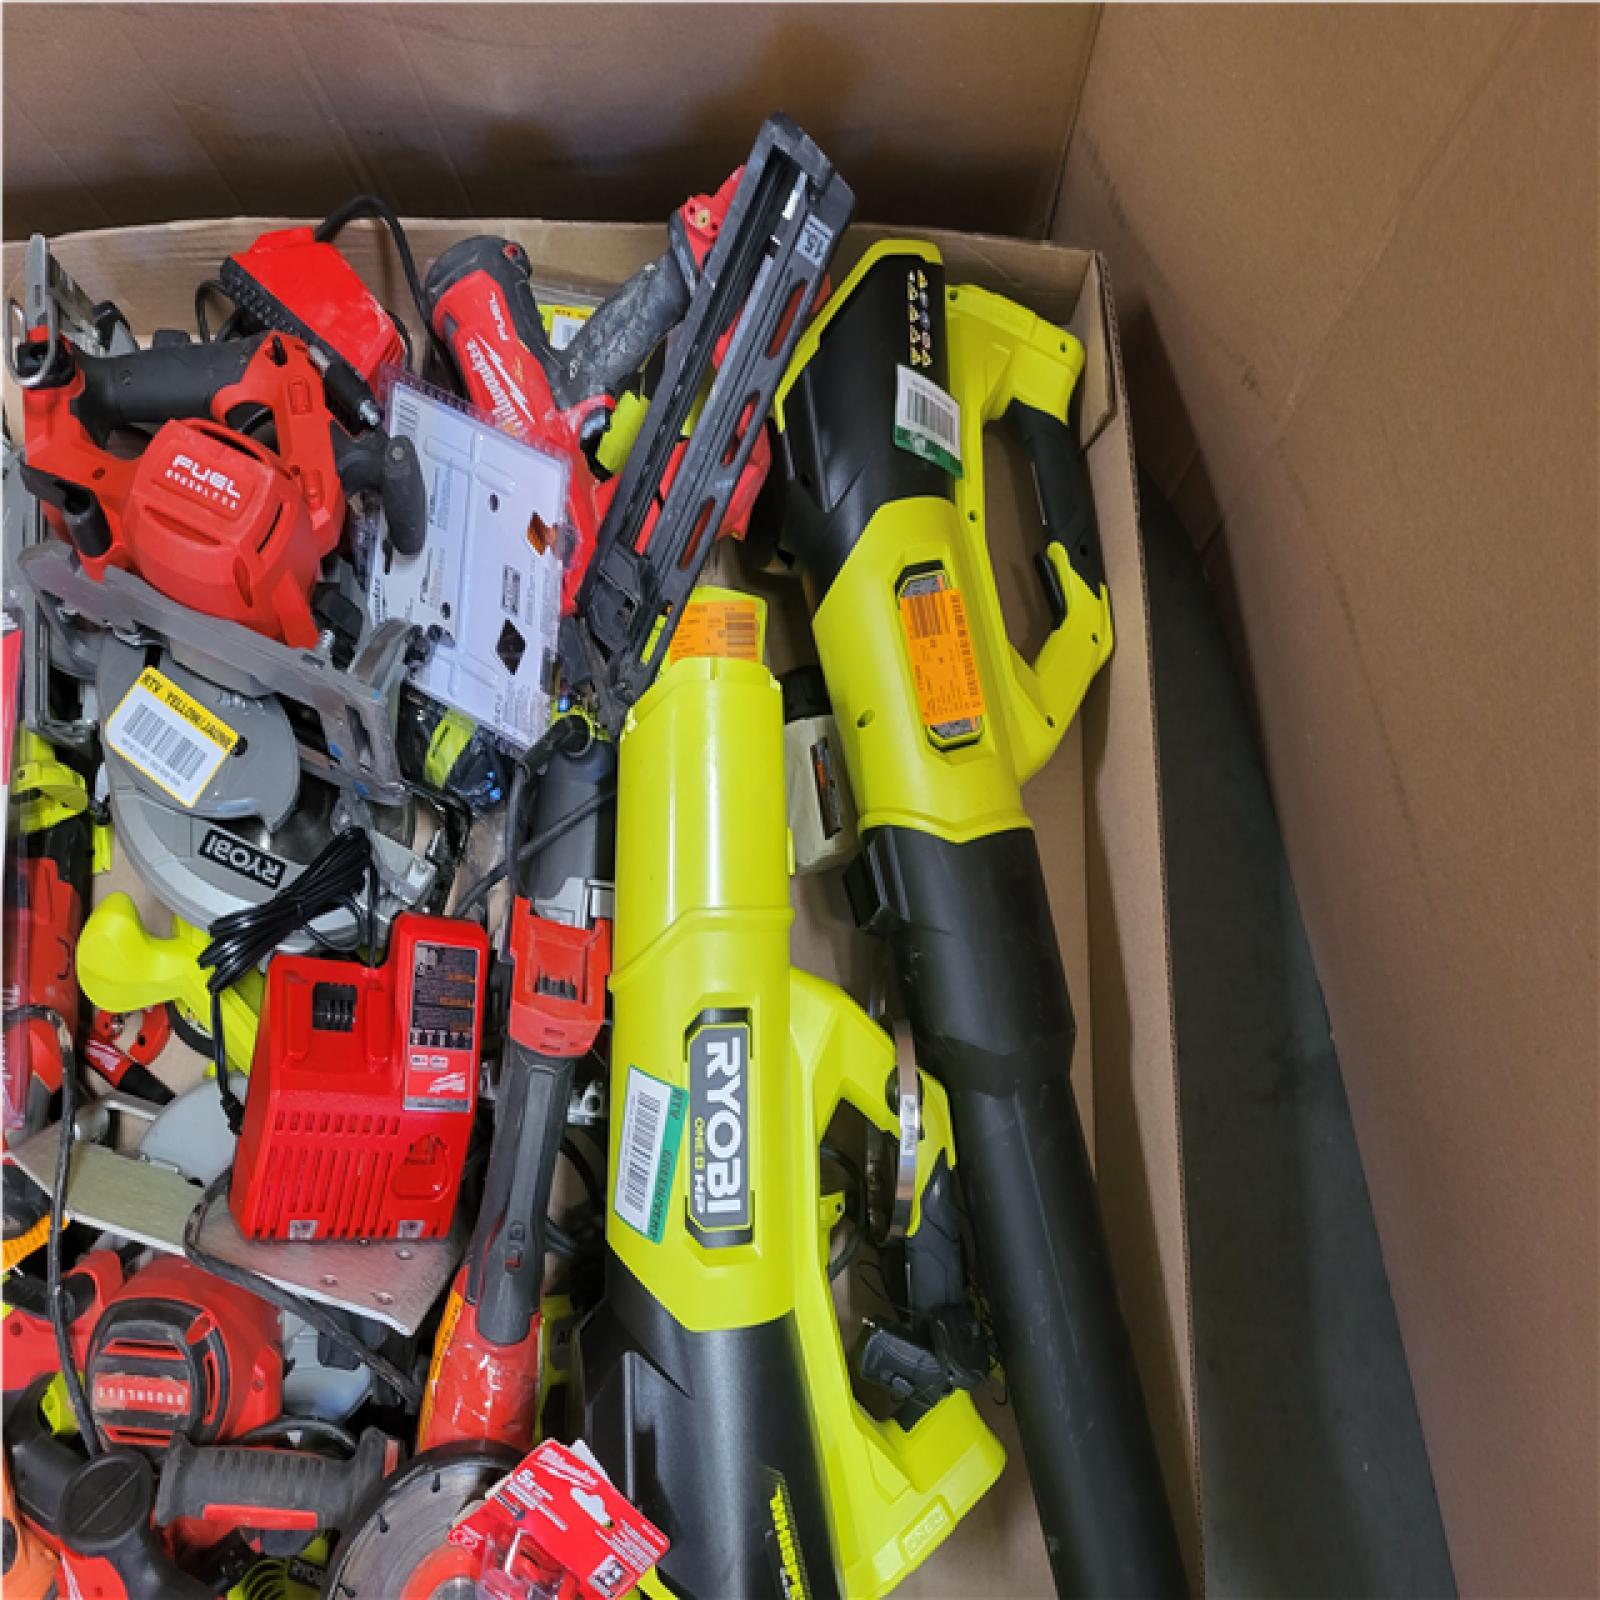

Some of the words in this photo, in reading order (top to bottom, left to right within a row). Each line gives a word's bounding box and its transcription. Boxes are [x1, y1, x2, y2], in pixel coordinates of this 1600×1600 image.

[172, 454, 241, 499] FUEL
[204, 834, 281, 883] RYOBI
[706, 1036, 741, 1214] RYOBI
